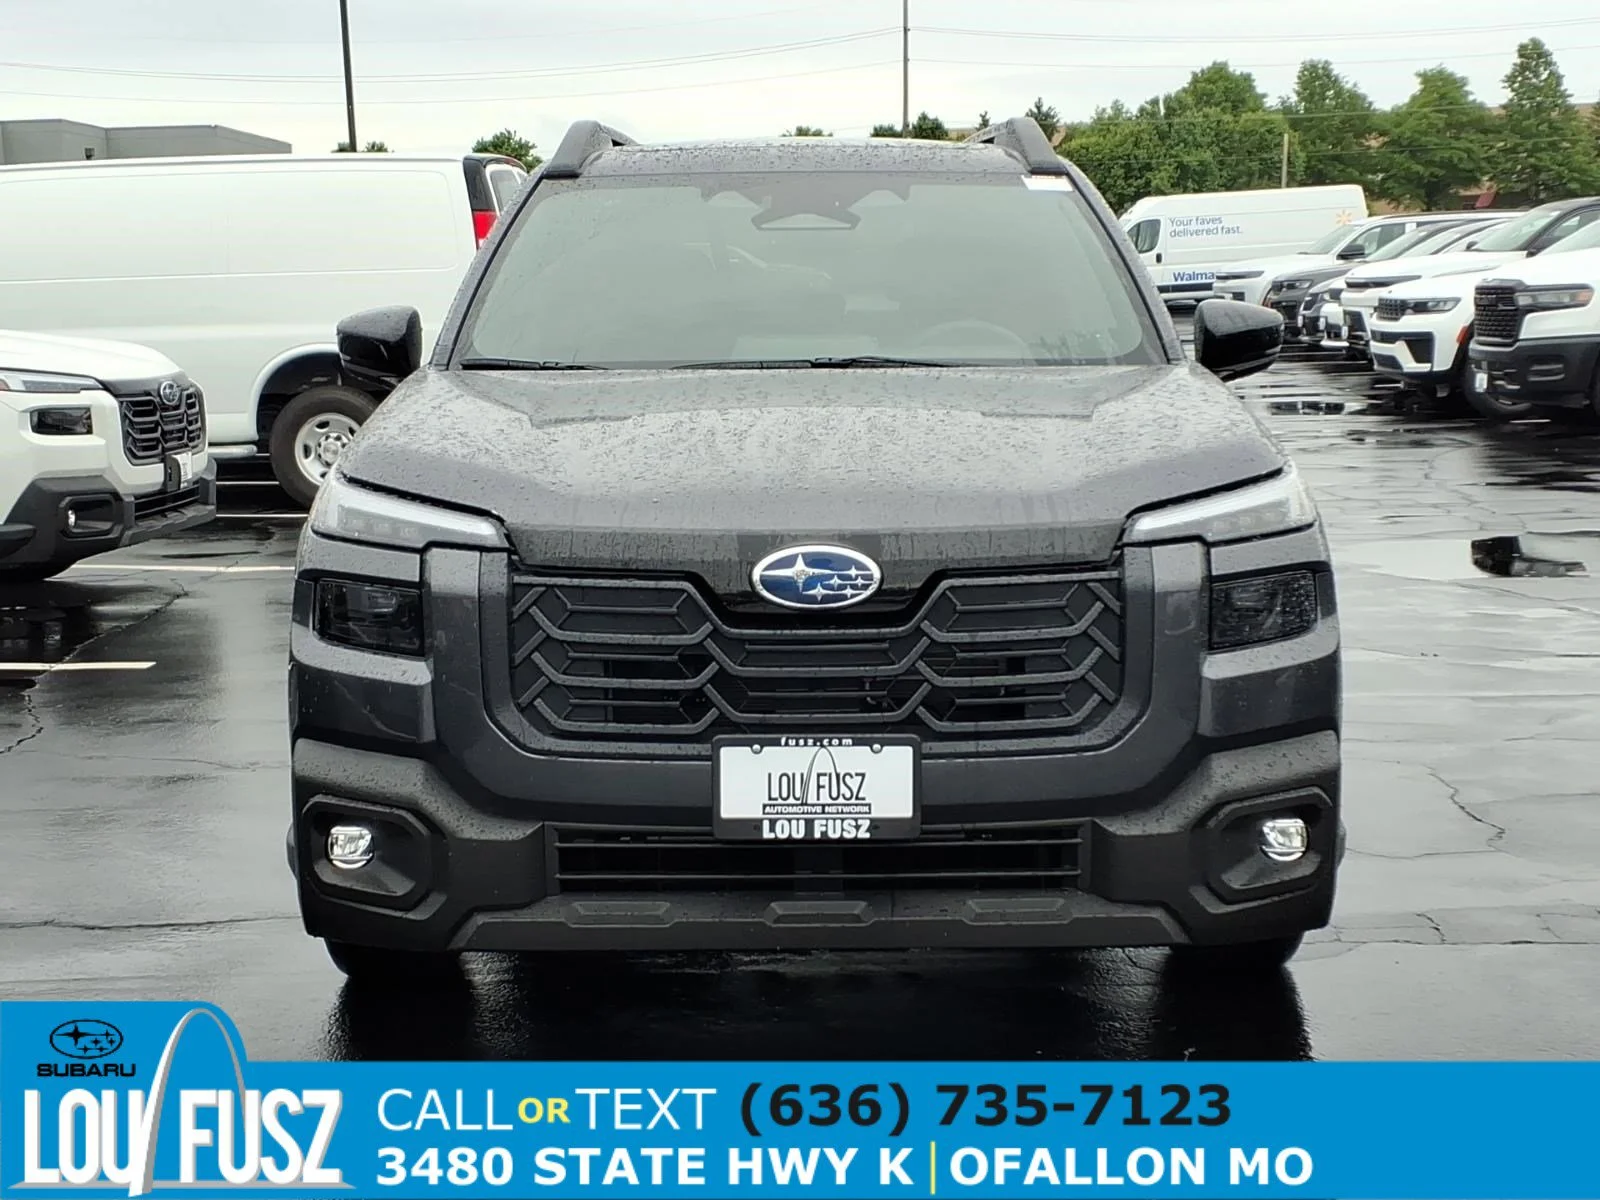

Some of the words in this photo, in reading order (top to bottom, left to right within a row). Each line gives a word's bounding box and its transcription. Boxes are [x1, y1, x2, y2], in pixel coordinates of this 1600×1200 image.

[1169, 217, 1193, 227] Your
[1196, 216, 1222, 225] faves
[1169, 226, 1219, 238] delivered
[1221, 225, 1243, 235] fast.
[1173, 271, 1215, 282] Walma
[780, 736, 853, 746] fusz.com
[767, 772, 804, 802] LOU
[816, 772, 866, 802] FUSZ
[764, 805, 822, 814] AUTOMOTIVE
[824, 805, 870, 814] NETWORK
[762, 819, 805, 839] LOU
[814, 819, 871, 839] FUSZ
